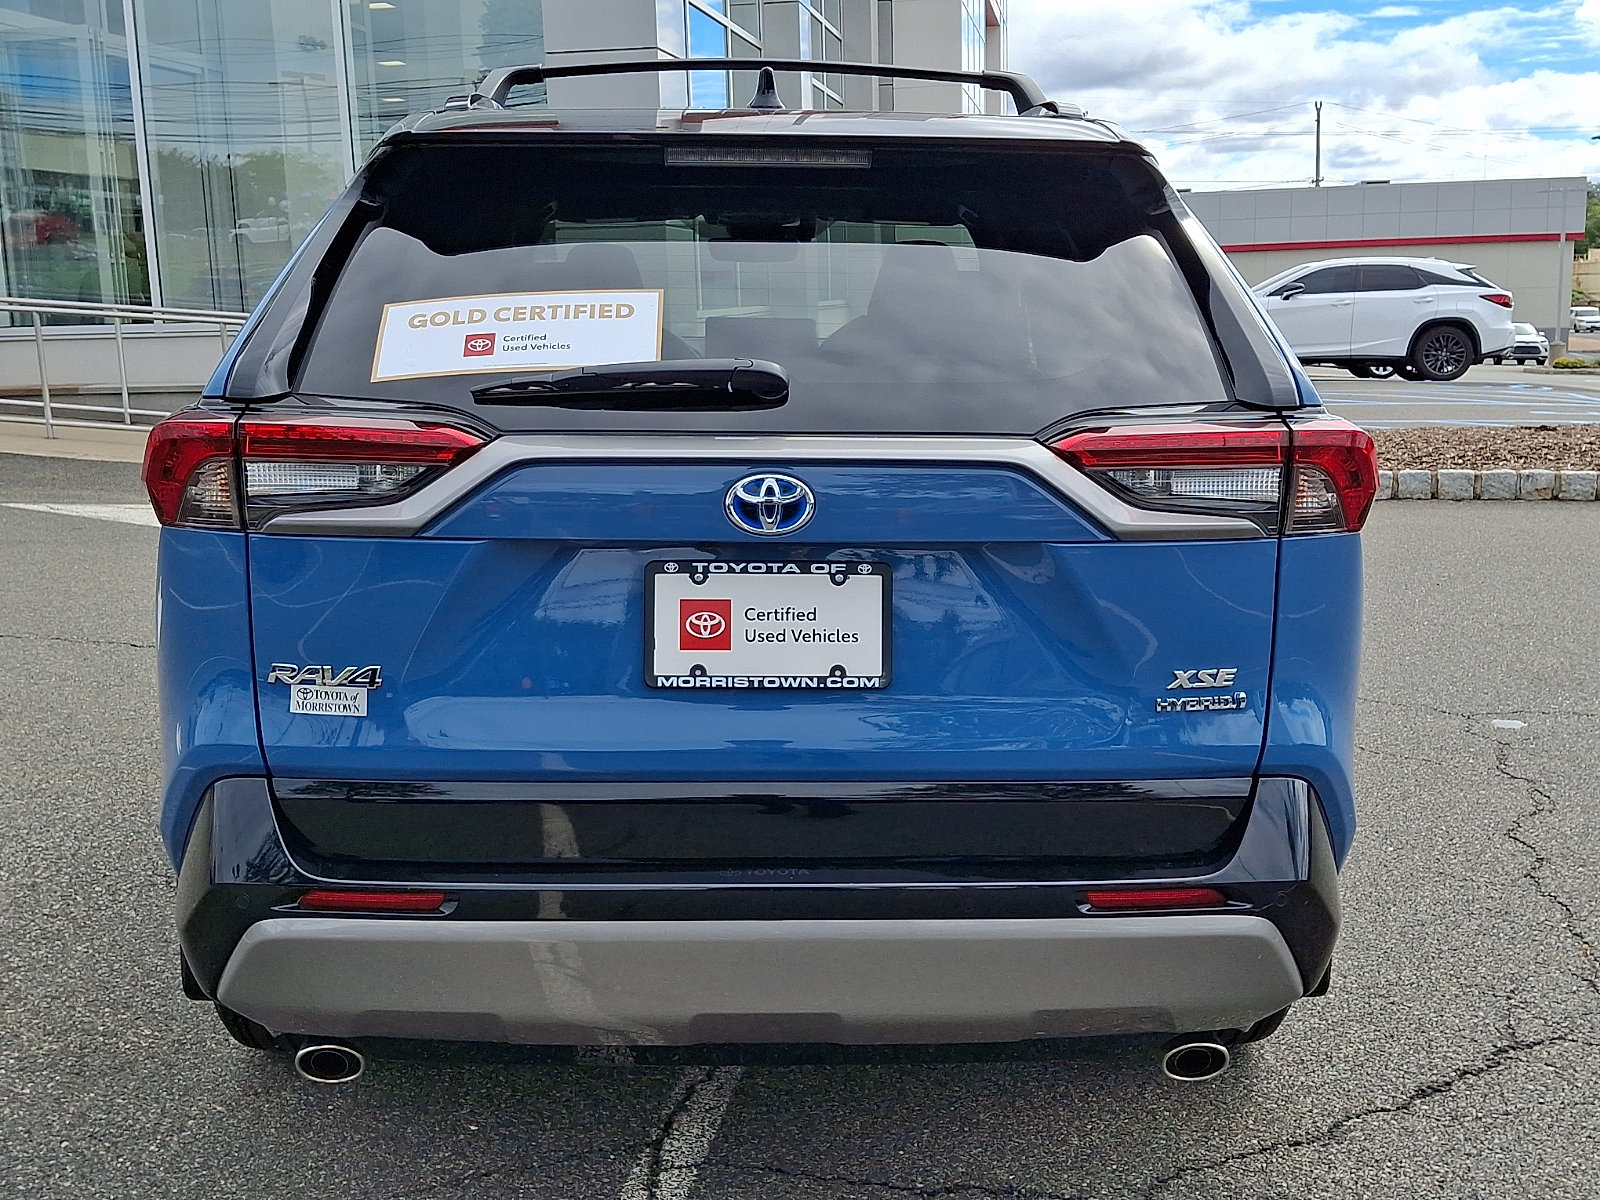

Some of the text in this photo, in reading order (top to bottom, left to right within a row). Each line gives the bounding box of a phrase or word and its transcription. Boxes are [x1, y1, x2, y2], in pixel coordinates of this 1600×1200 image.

[408, 303, 635, 329] GOLD CERTIFIED
[502, 333, 547, 342] Certified
[502, 341, 571, 352] Used Vehicles
[692, 562, 847, 573] TOYOTA OF
[744, 607, 817, 622] Certified
[745, 629, 859, 643] Used Vehicles
[267, 662, 383, 689] RAV4
[657, 676, 880, 688] MORRISTOWN.COM
[1166, 668, 1238, 689] XSE
[314, 689, 360, 703] TOYOTA of
[295, 700, 360, 713] MORRISTOWN
[1156, 695, 1236, 712] HYBRID
[747, 868, 810, 876] TOYOTA
